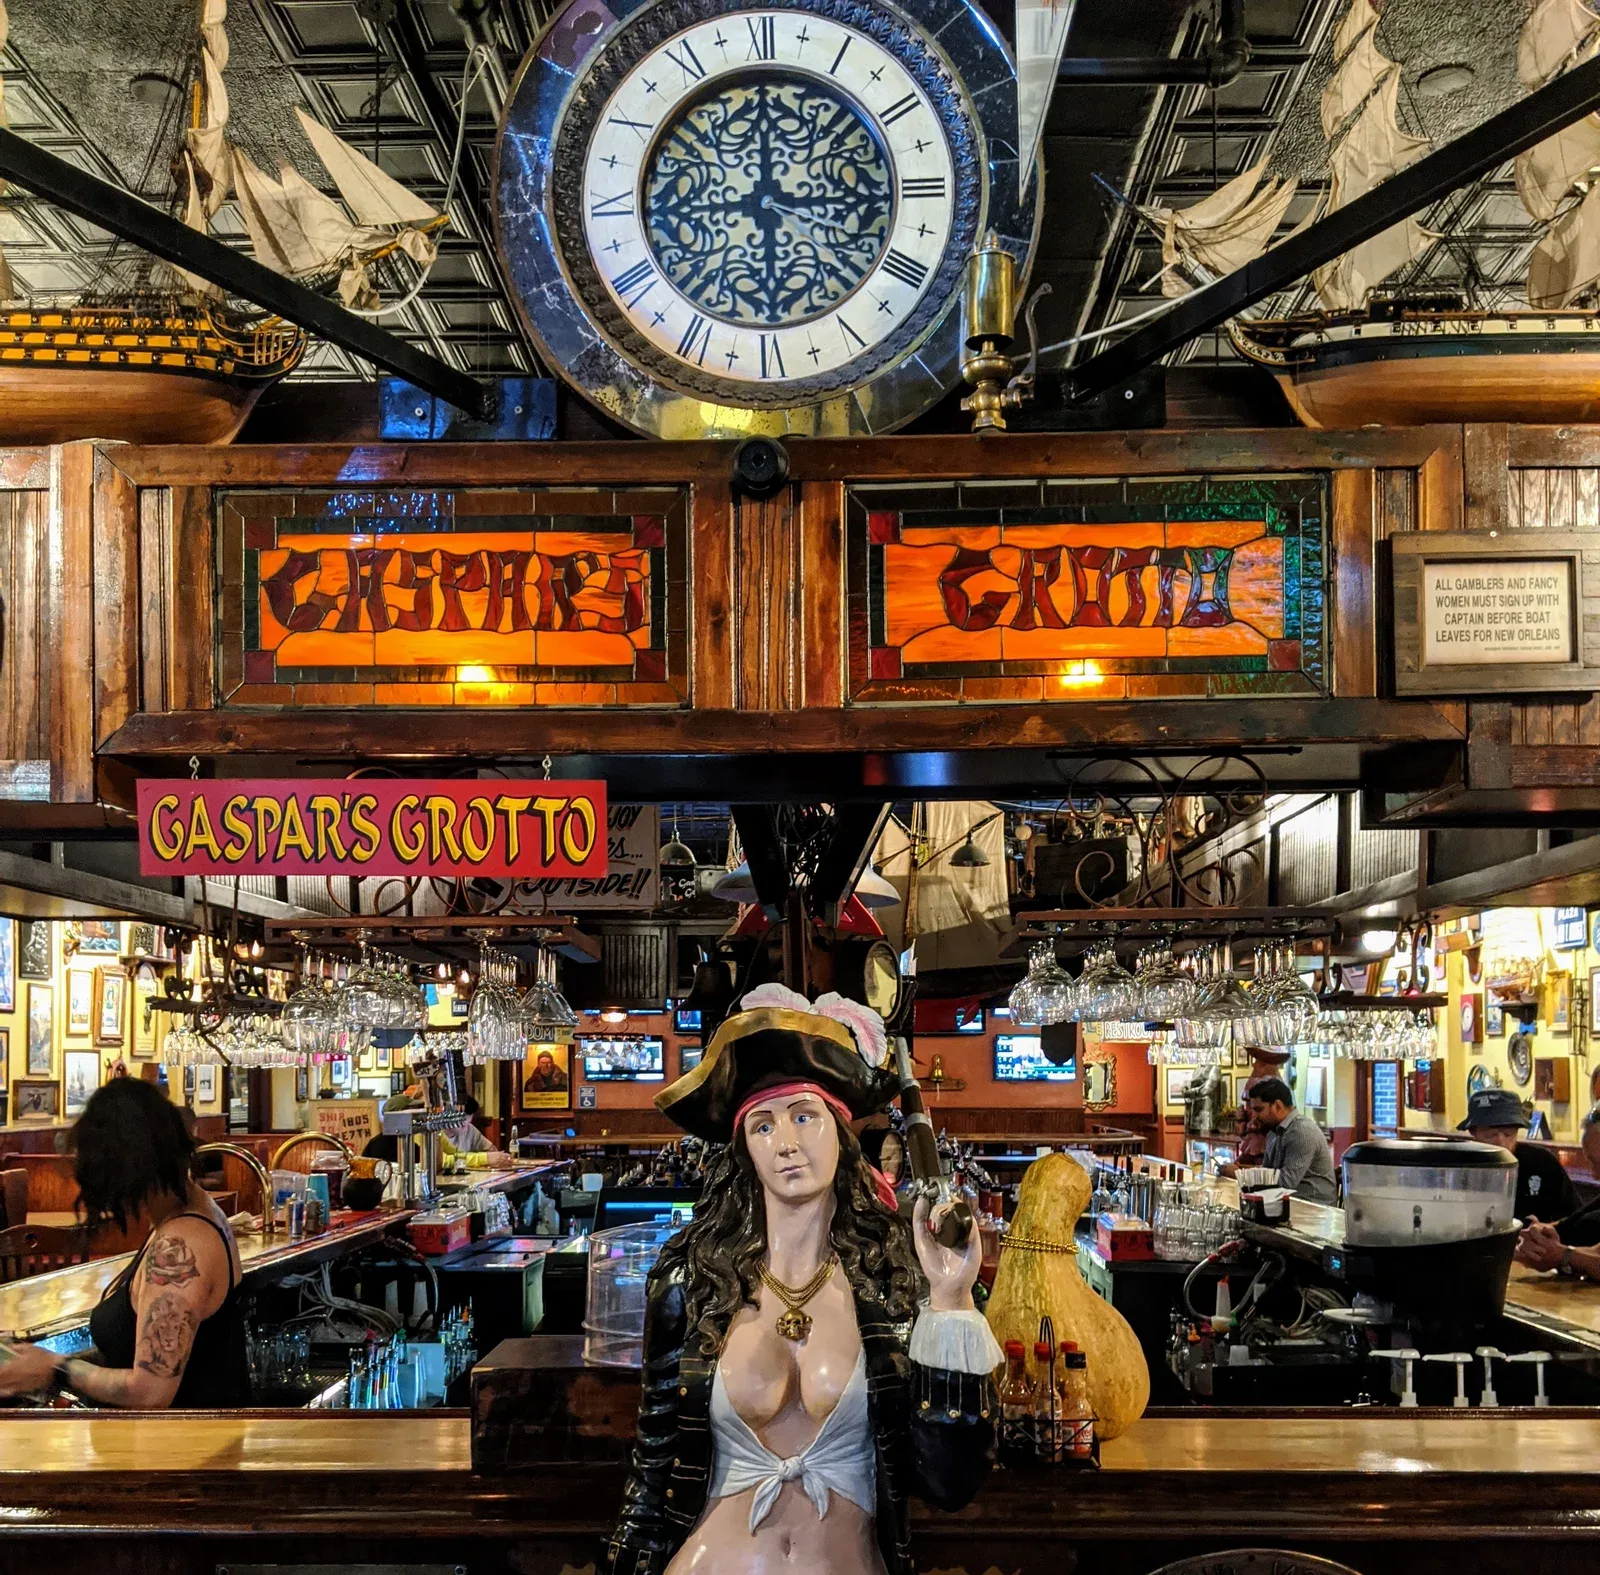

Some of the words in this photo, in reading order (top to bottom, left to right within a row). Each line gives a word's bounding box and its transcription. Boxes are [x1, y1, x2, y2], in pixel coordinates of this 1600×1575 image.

[939, 545, 1235, 631] GROTTO
[1435, 578, 1452, 590] ALL
[1455, 578, 1504, 590] GAMBLERS
[1507, 578, 1525, 590] AND
[1529, 577, 1558, 589] FANCY
[1436, 595, 1470, 608] WOMEN
[1472, 595, 1496, 607] MUST
[1500, 595, 1520, 607] SIGN
[1523, 595, 1534, 606] UP
[1536, 594, 1559, 606] WITH
[1444, 612, 1484, 625] CAPTAIN
[1487, 612, 1523, 624] BEFORE
[1526, 611, 1551, 624] BOAT
[1436, 630, 1471, 643] LEAVES
[1474, 630, 1492, 642] FOR
[1495, 629, 1515, 642] NEW
[1518, 628, 1560, 641] ORLEANS
[149, 793, 382, 863] GASPAR'S
[388, 794, 599, 865] GROTTO
[342, 1114, 369, 1128] 1805
